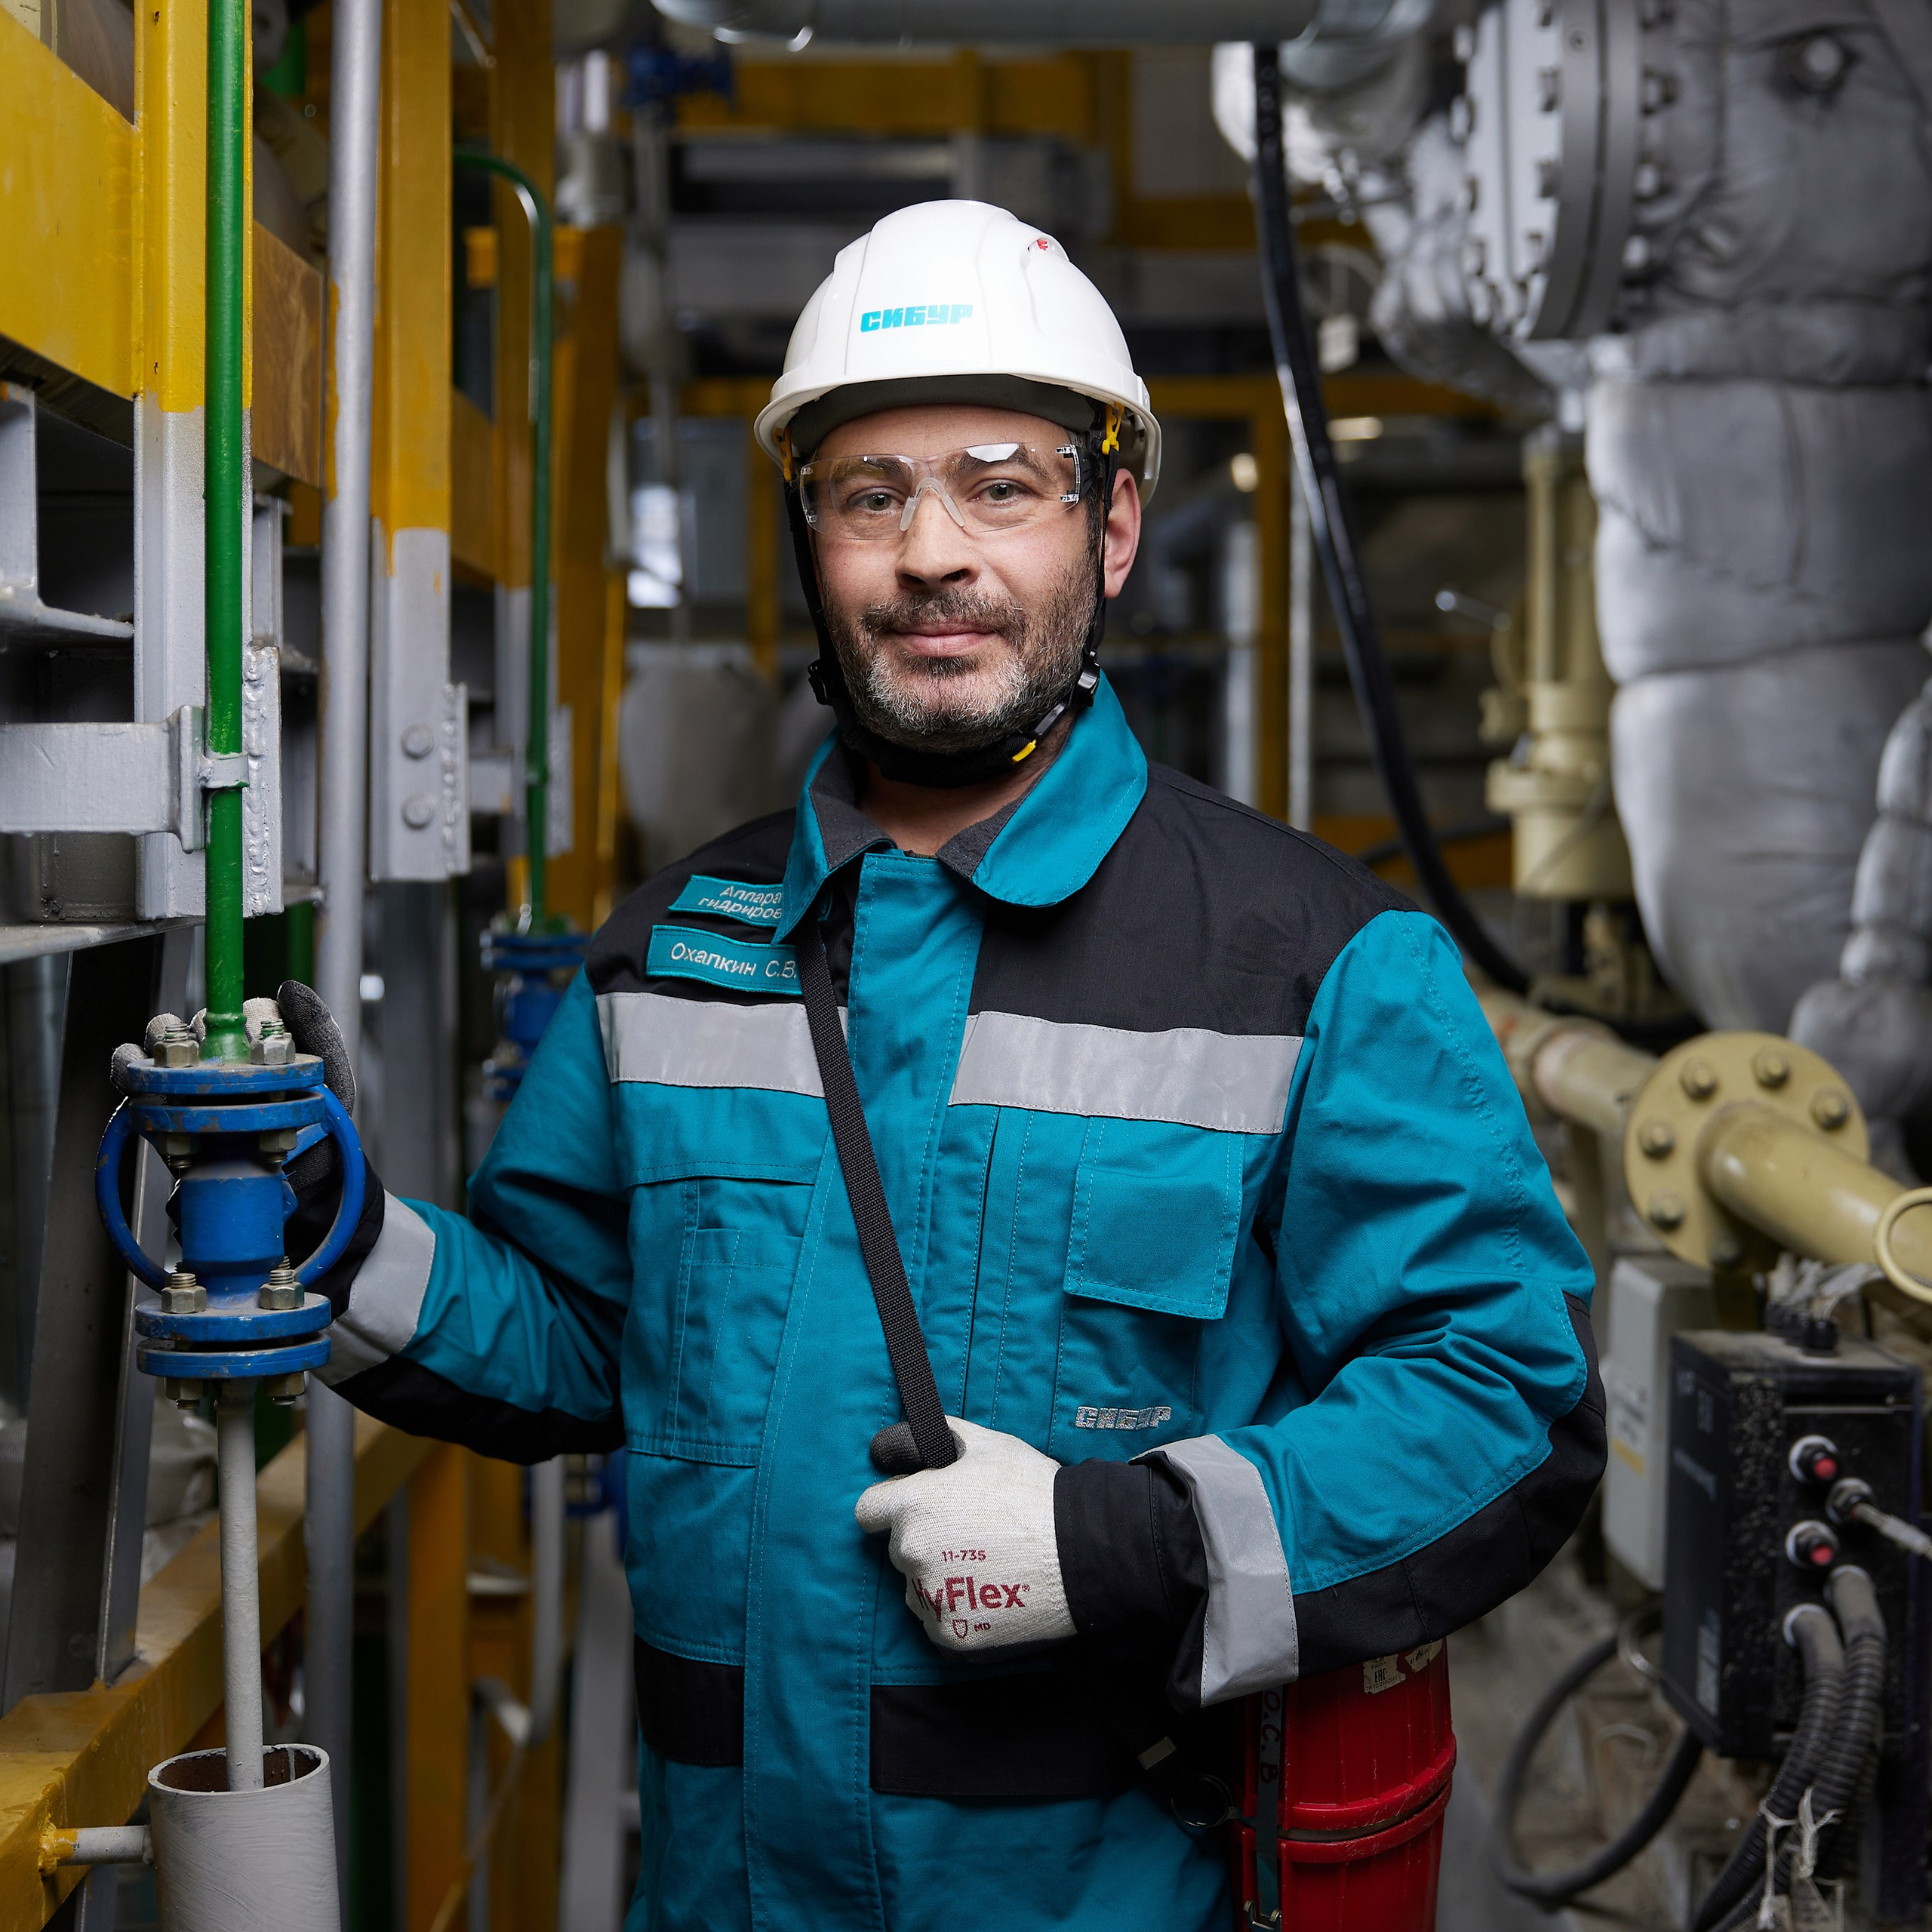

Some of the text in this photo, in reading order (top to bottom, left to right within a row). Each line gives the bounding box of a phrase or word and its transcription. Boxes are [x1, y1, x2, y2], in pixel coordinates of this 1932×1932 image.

[860, 304, 974, 333] СИБУР
[670, 942, 797, 979] Охапкин С.В.
[1075, 1406, 1172, 1430] СИБУР
[942, 1549, 986, 1562] 11-735
[974, 1623, 992, 1632] MD
